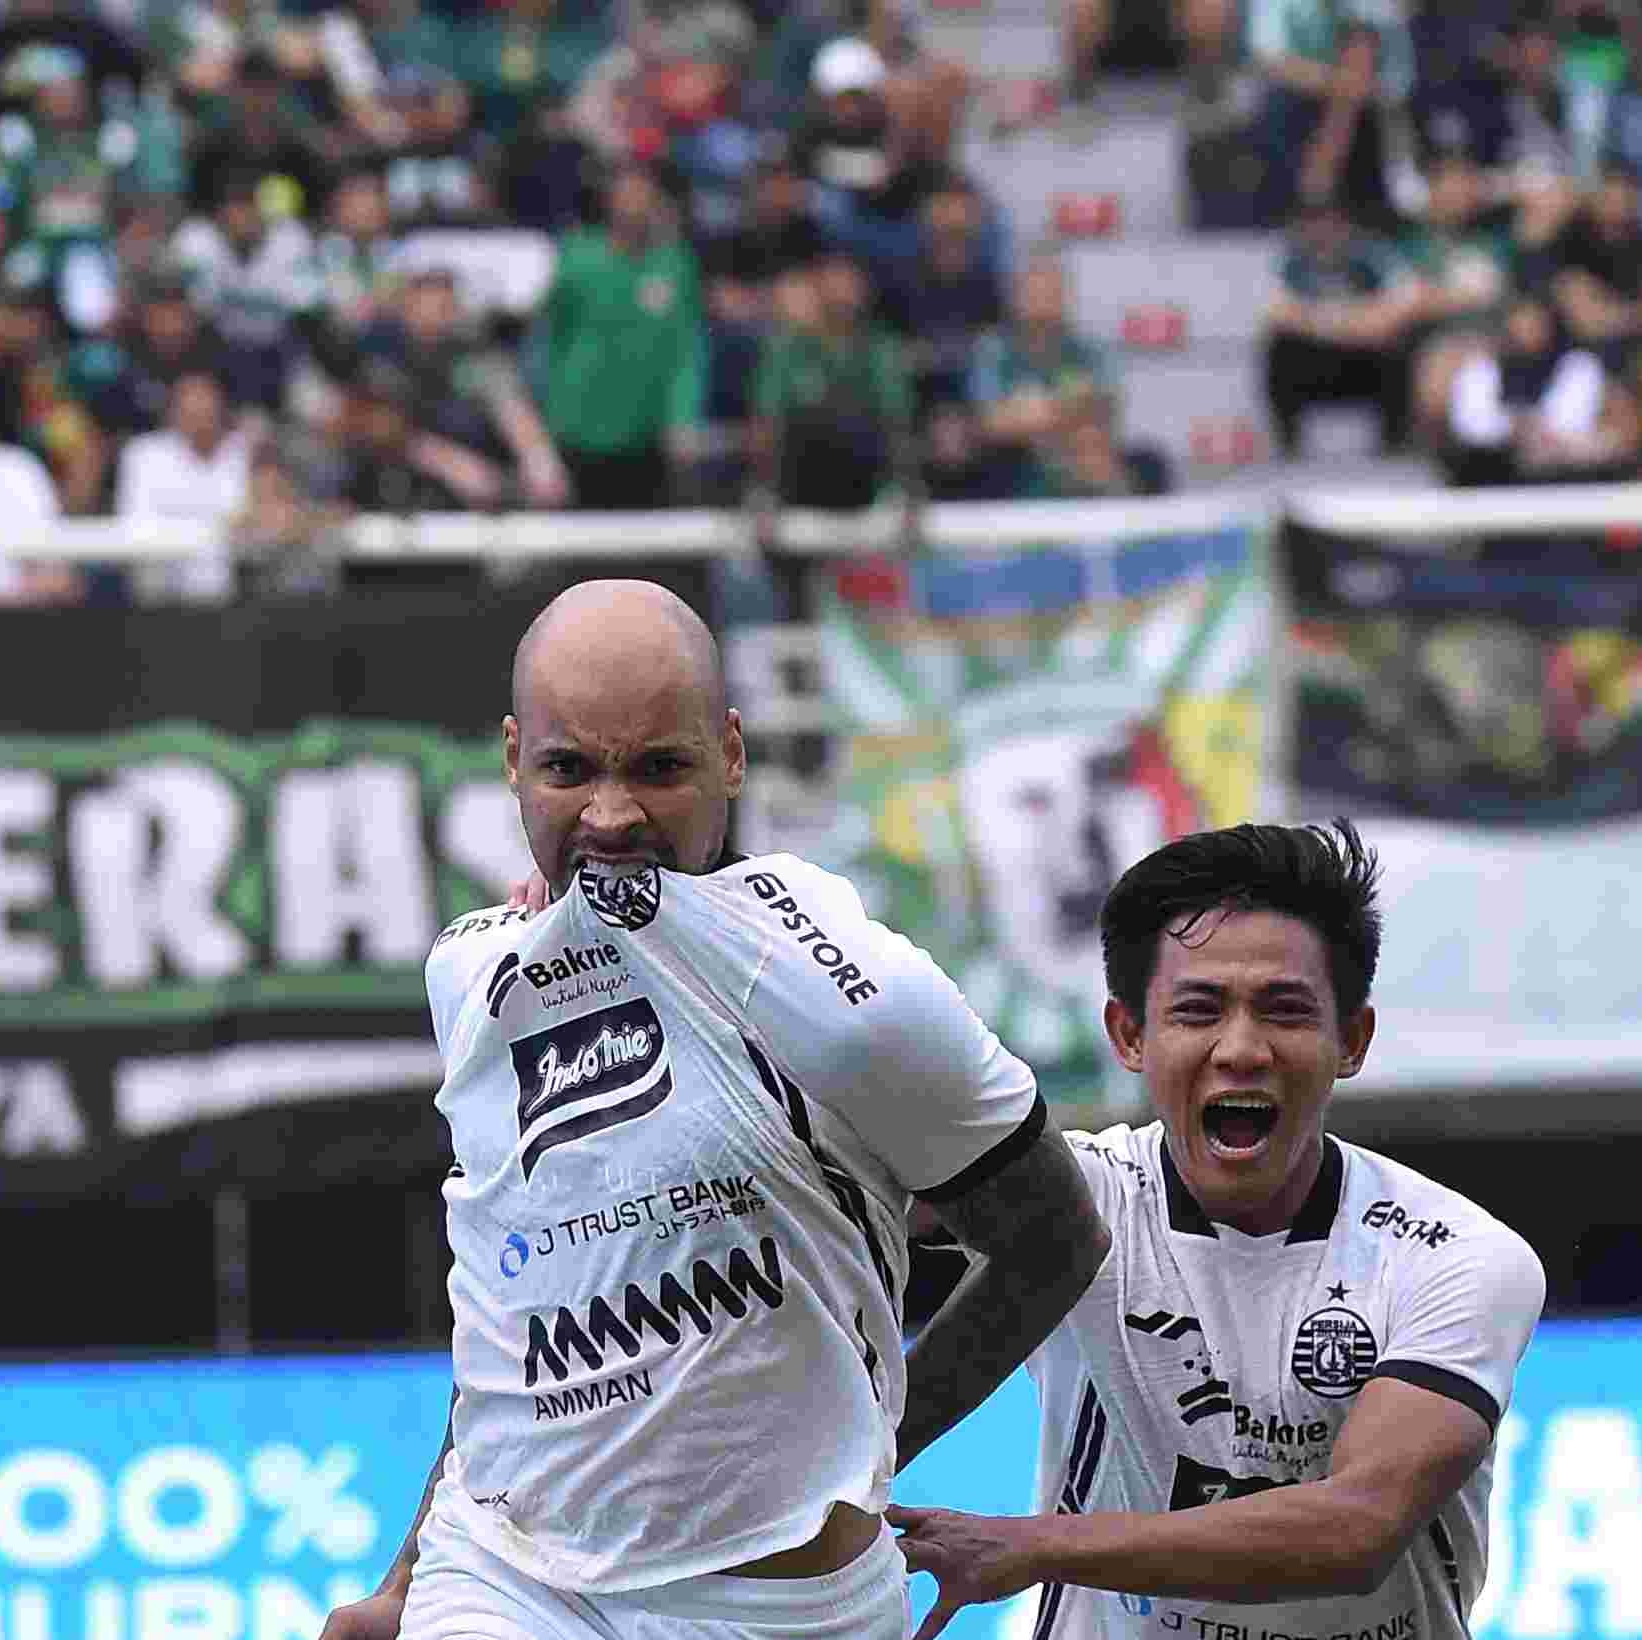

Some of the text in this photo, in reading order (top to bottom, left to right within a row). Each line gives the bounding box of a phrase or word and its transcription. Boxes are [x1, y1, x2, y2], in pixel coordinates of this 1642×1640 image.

[522, 940, 622, 990] Bakrie
[536, 1174, 758, 1256] J TRUST BANK
[534, 1369, 654, 1422] AMMAN
[1160, 1611, 1183, 1631] J
